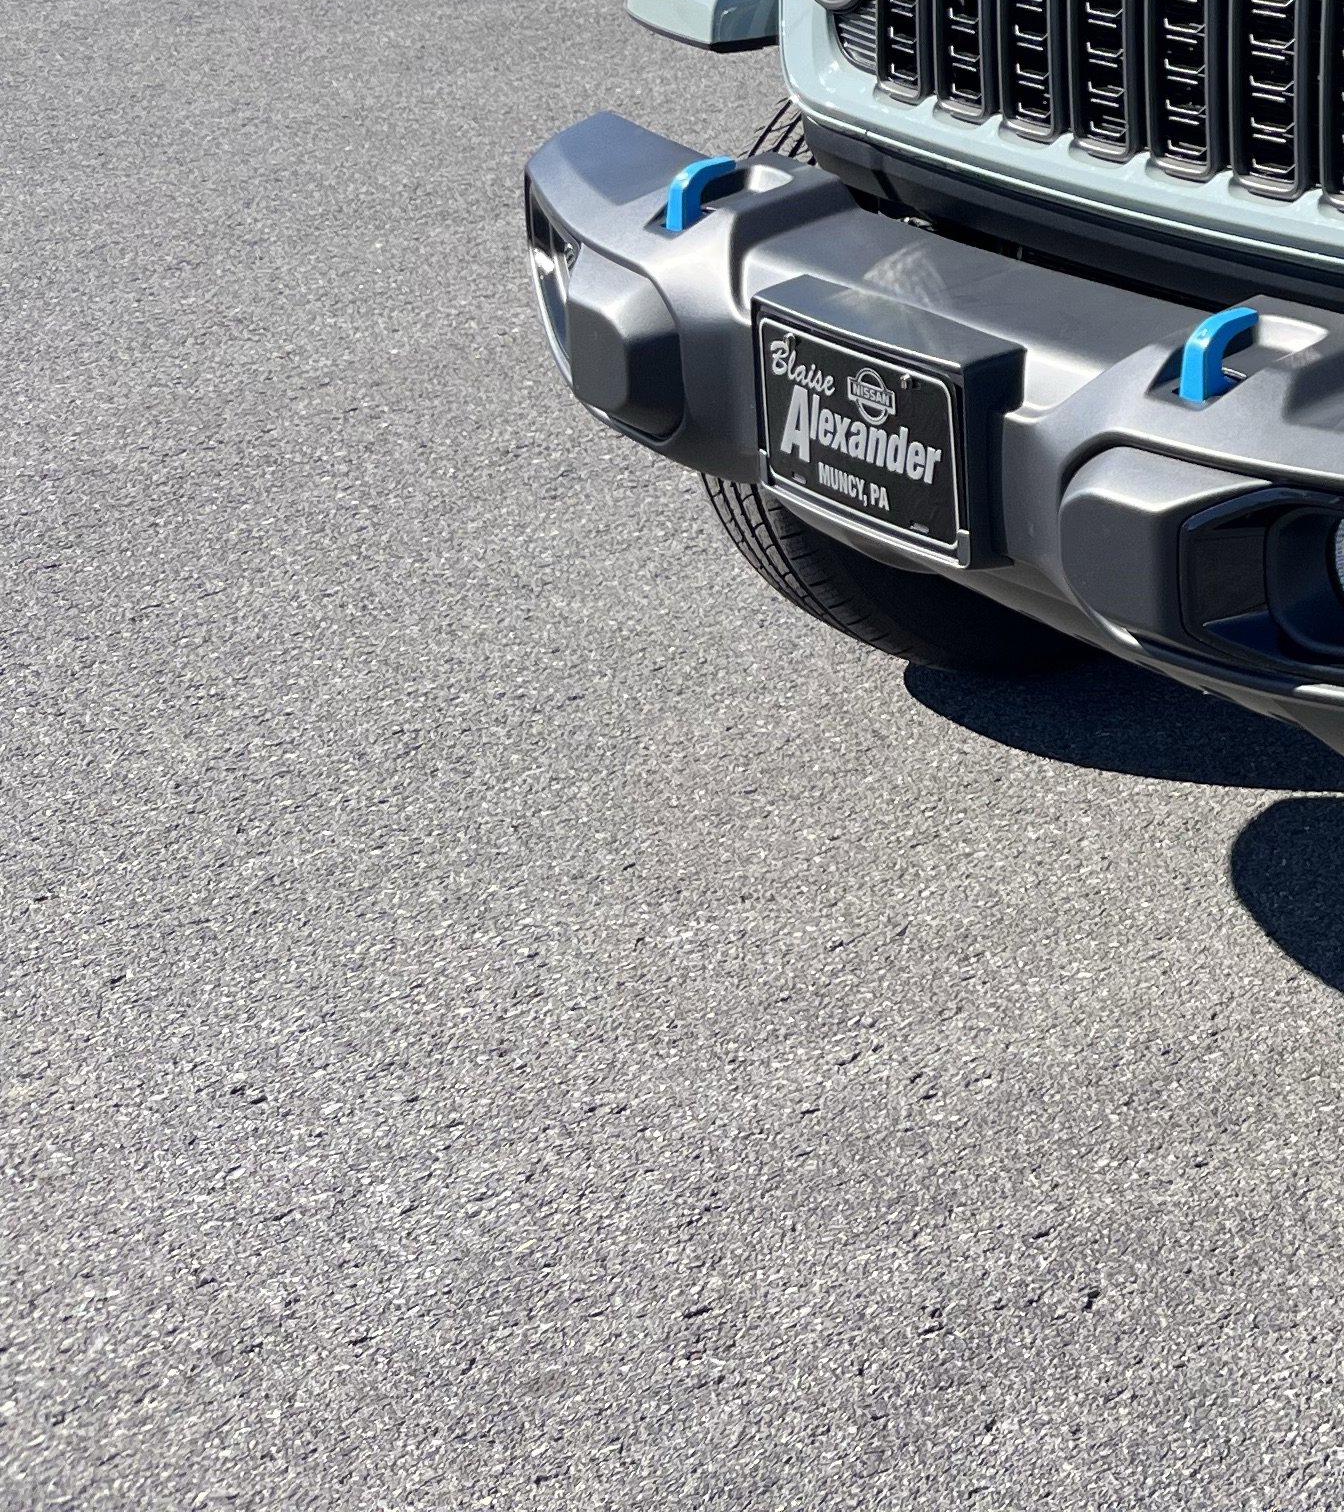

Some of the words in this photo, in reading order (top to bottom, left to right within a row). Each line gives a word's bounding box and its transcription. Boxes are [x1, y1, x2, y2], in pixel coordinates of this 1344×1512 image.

[770, 339, 836, 396] Blaise
[852, 382, 890, 407] NISSAN
[780, 384, 942, 485] Alexander
[817, 461, 868, 507] MUNCY,
[870, 482, 890, 511] PA
